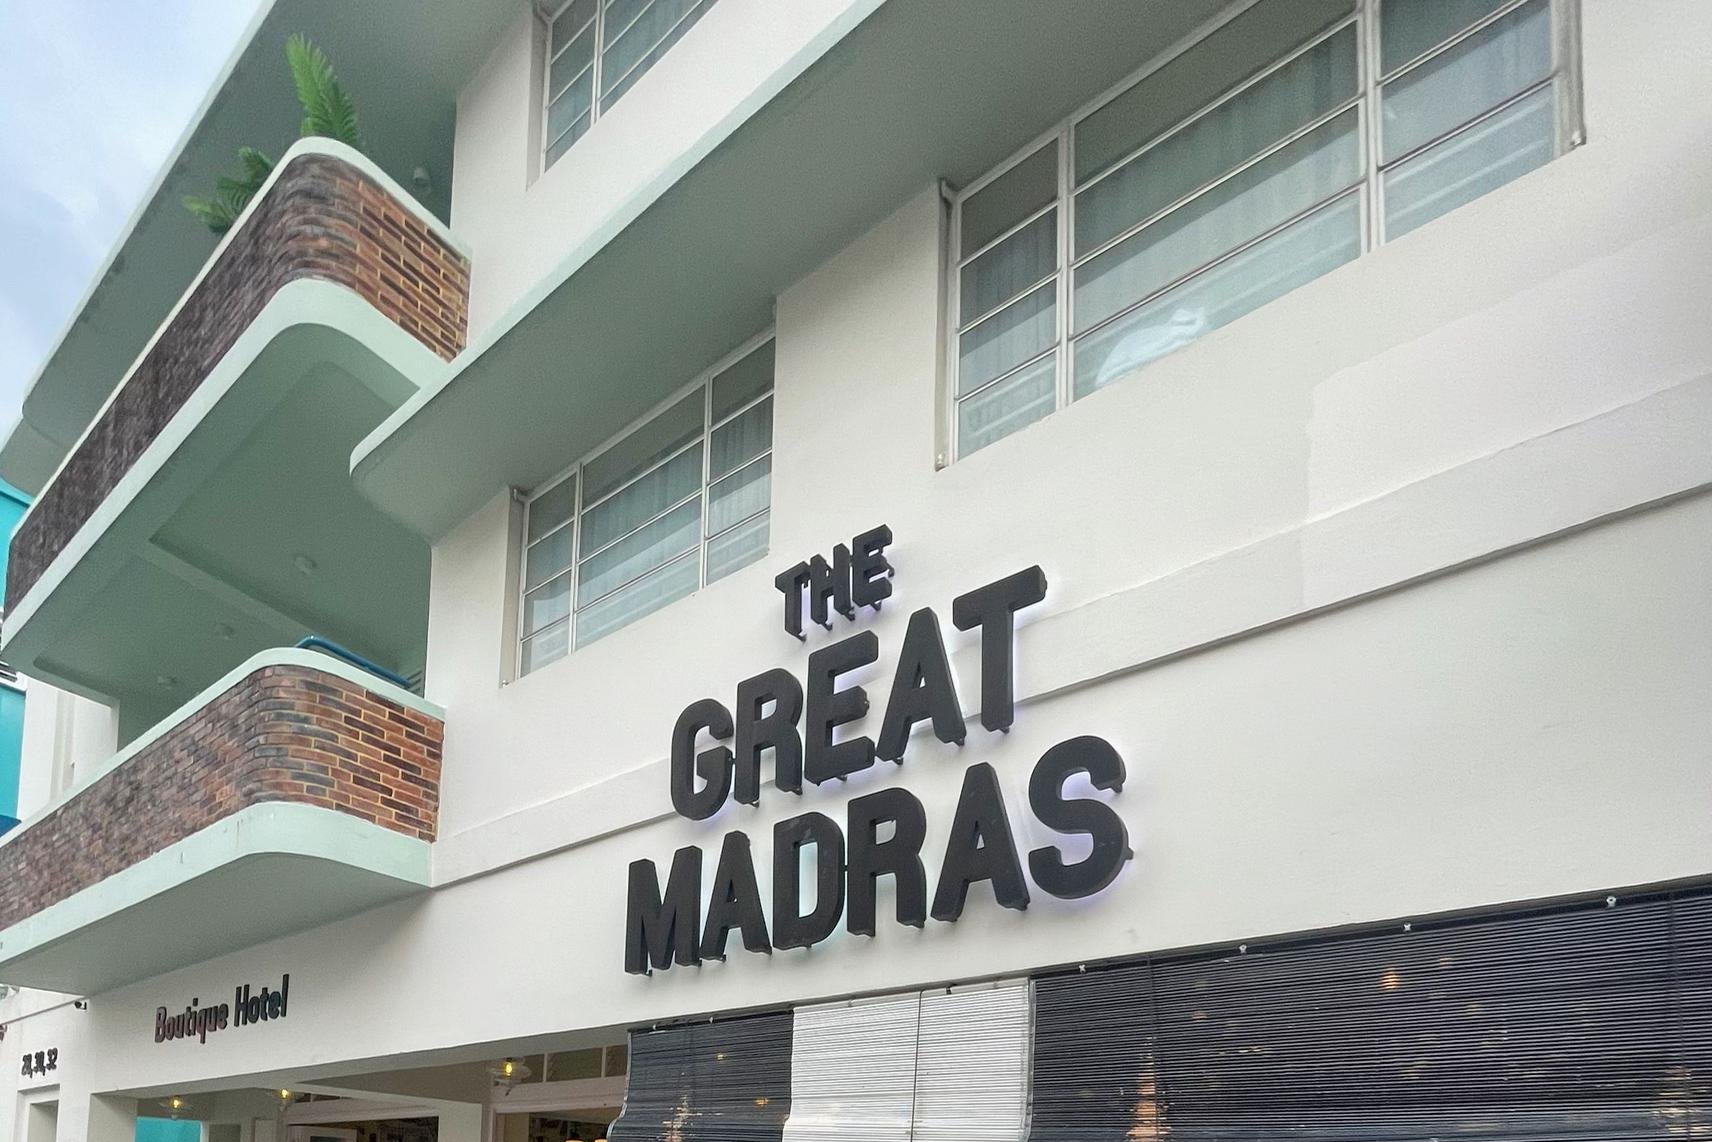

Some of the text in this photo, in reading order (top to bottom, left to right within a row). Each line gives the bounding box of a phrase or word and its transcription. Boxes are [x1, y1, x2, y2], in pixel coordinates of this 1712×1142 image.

[774, 524, 894, 640] THE
[670, 565, 1048, 821] GREAT
[624, 735, 1133, 975] MADRAS
[154, 973, 290, 1044] Boutique Hotel
